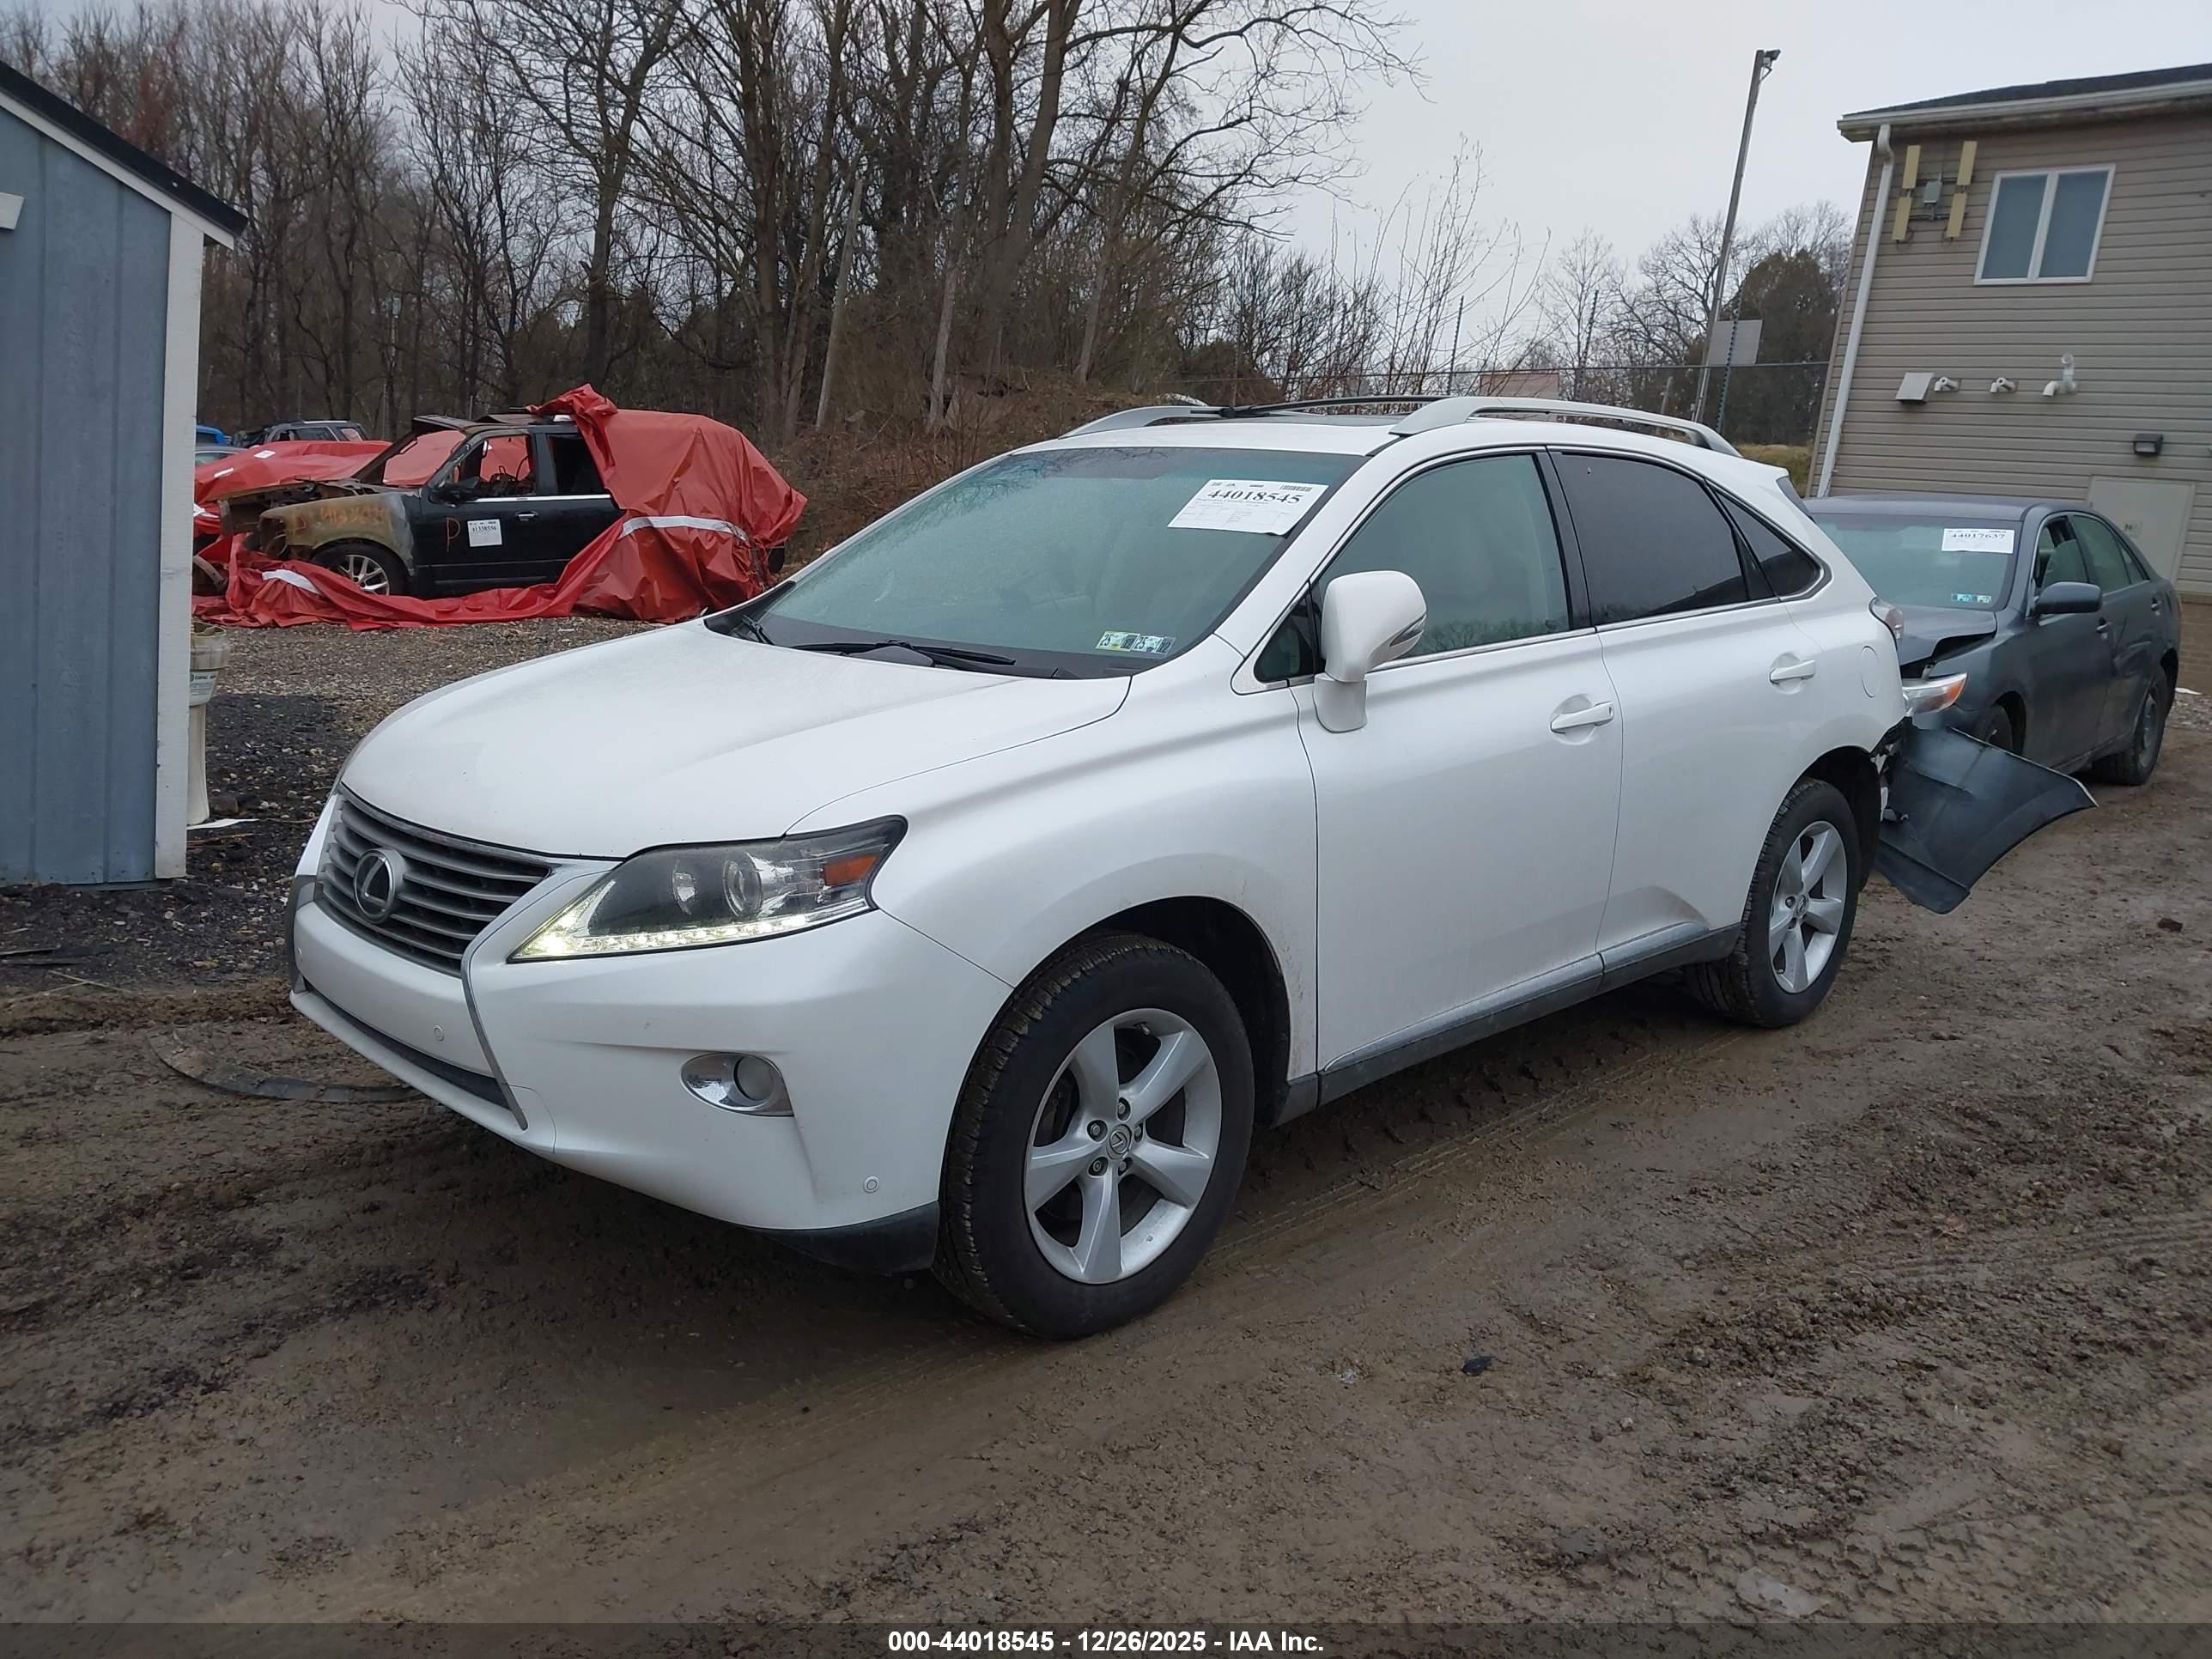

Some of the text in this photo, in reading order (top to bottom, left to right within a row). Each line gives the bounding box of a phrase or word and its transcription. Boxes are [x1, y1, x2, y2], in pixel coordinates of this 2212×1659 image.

[1207, 489, 1304, 504] 44018545
[446, 517, 461, 552] P
[1133, 636, 1149, 649] 25
